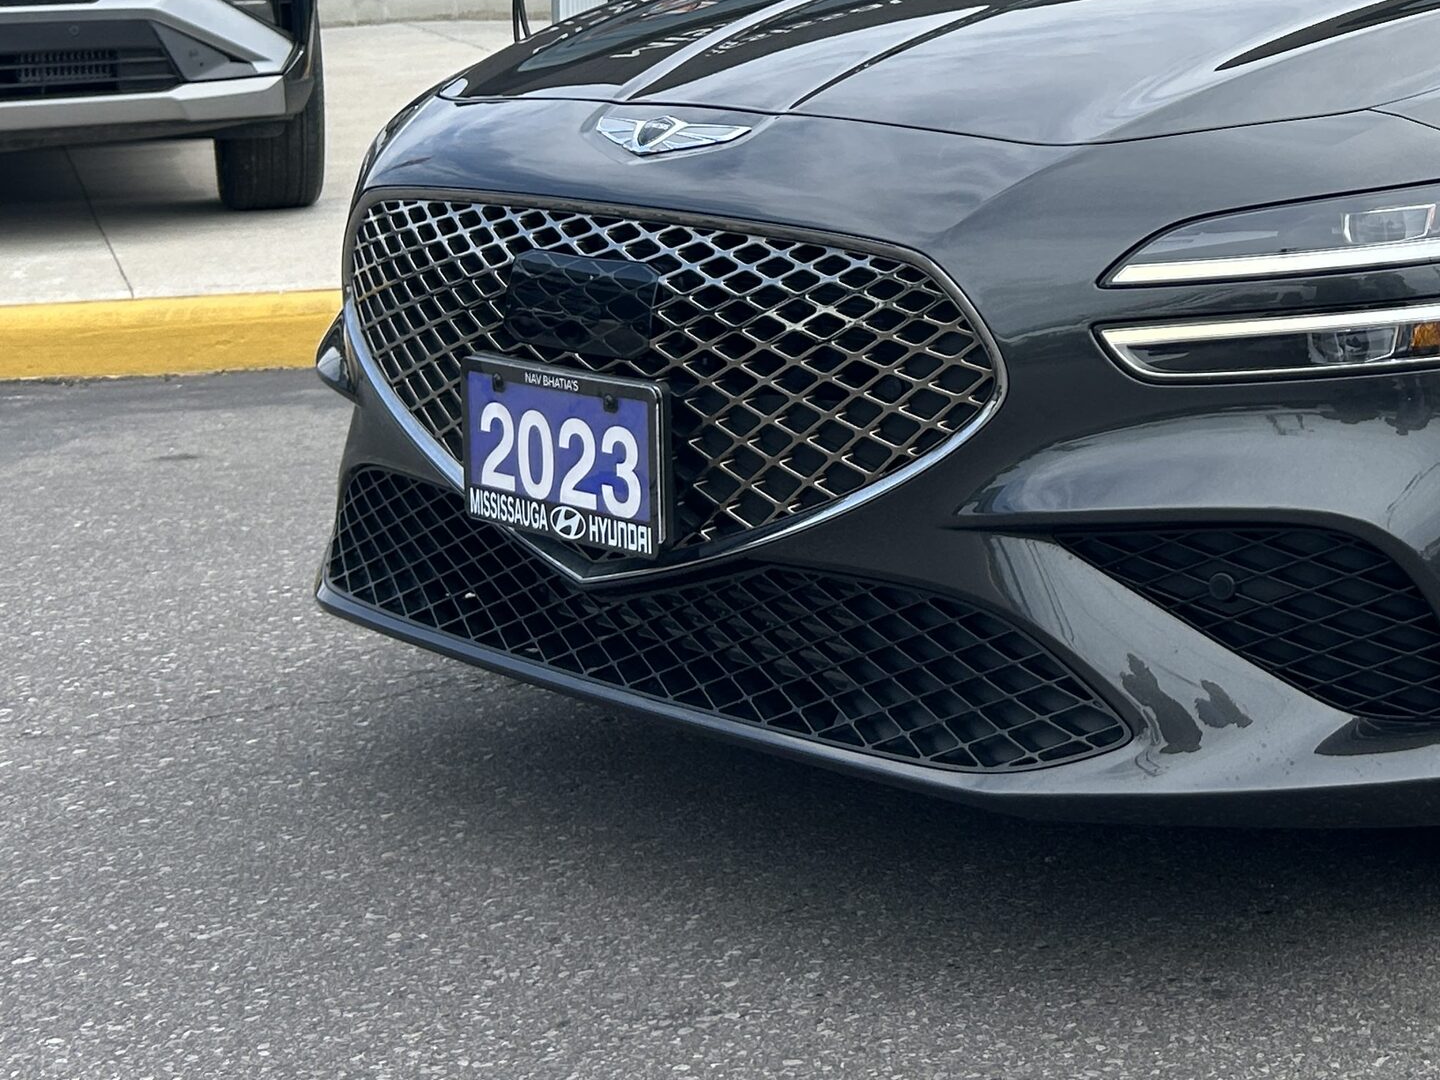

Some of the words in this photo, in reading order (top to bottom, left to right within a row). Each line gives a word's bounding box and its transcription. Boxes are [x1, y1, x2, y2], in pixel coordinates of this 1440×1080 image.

[525, 372, 542, 386] NAV
[542, 374, 579, 392] BHATIA'S
[480, 402, 641, 519] 2023
[470, 487, 549, 532] MISSISSAUGA
[589, 514, 652, 555] HYUNDAI
